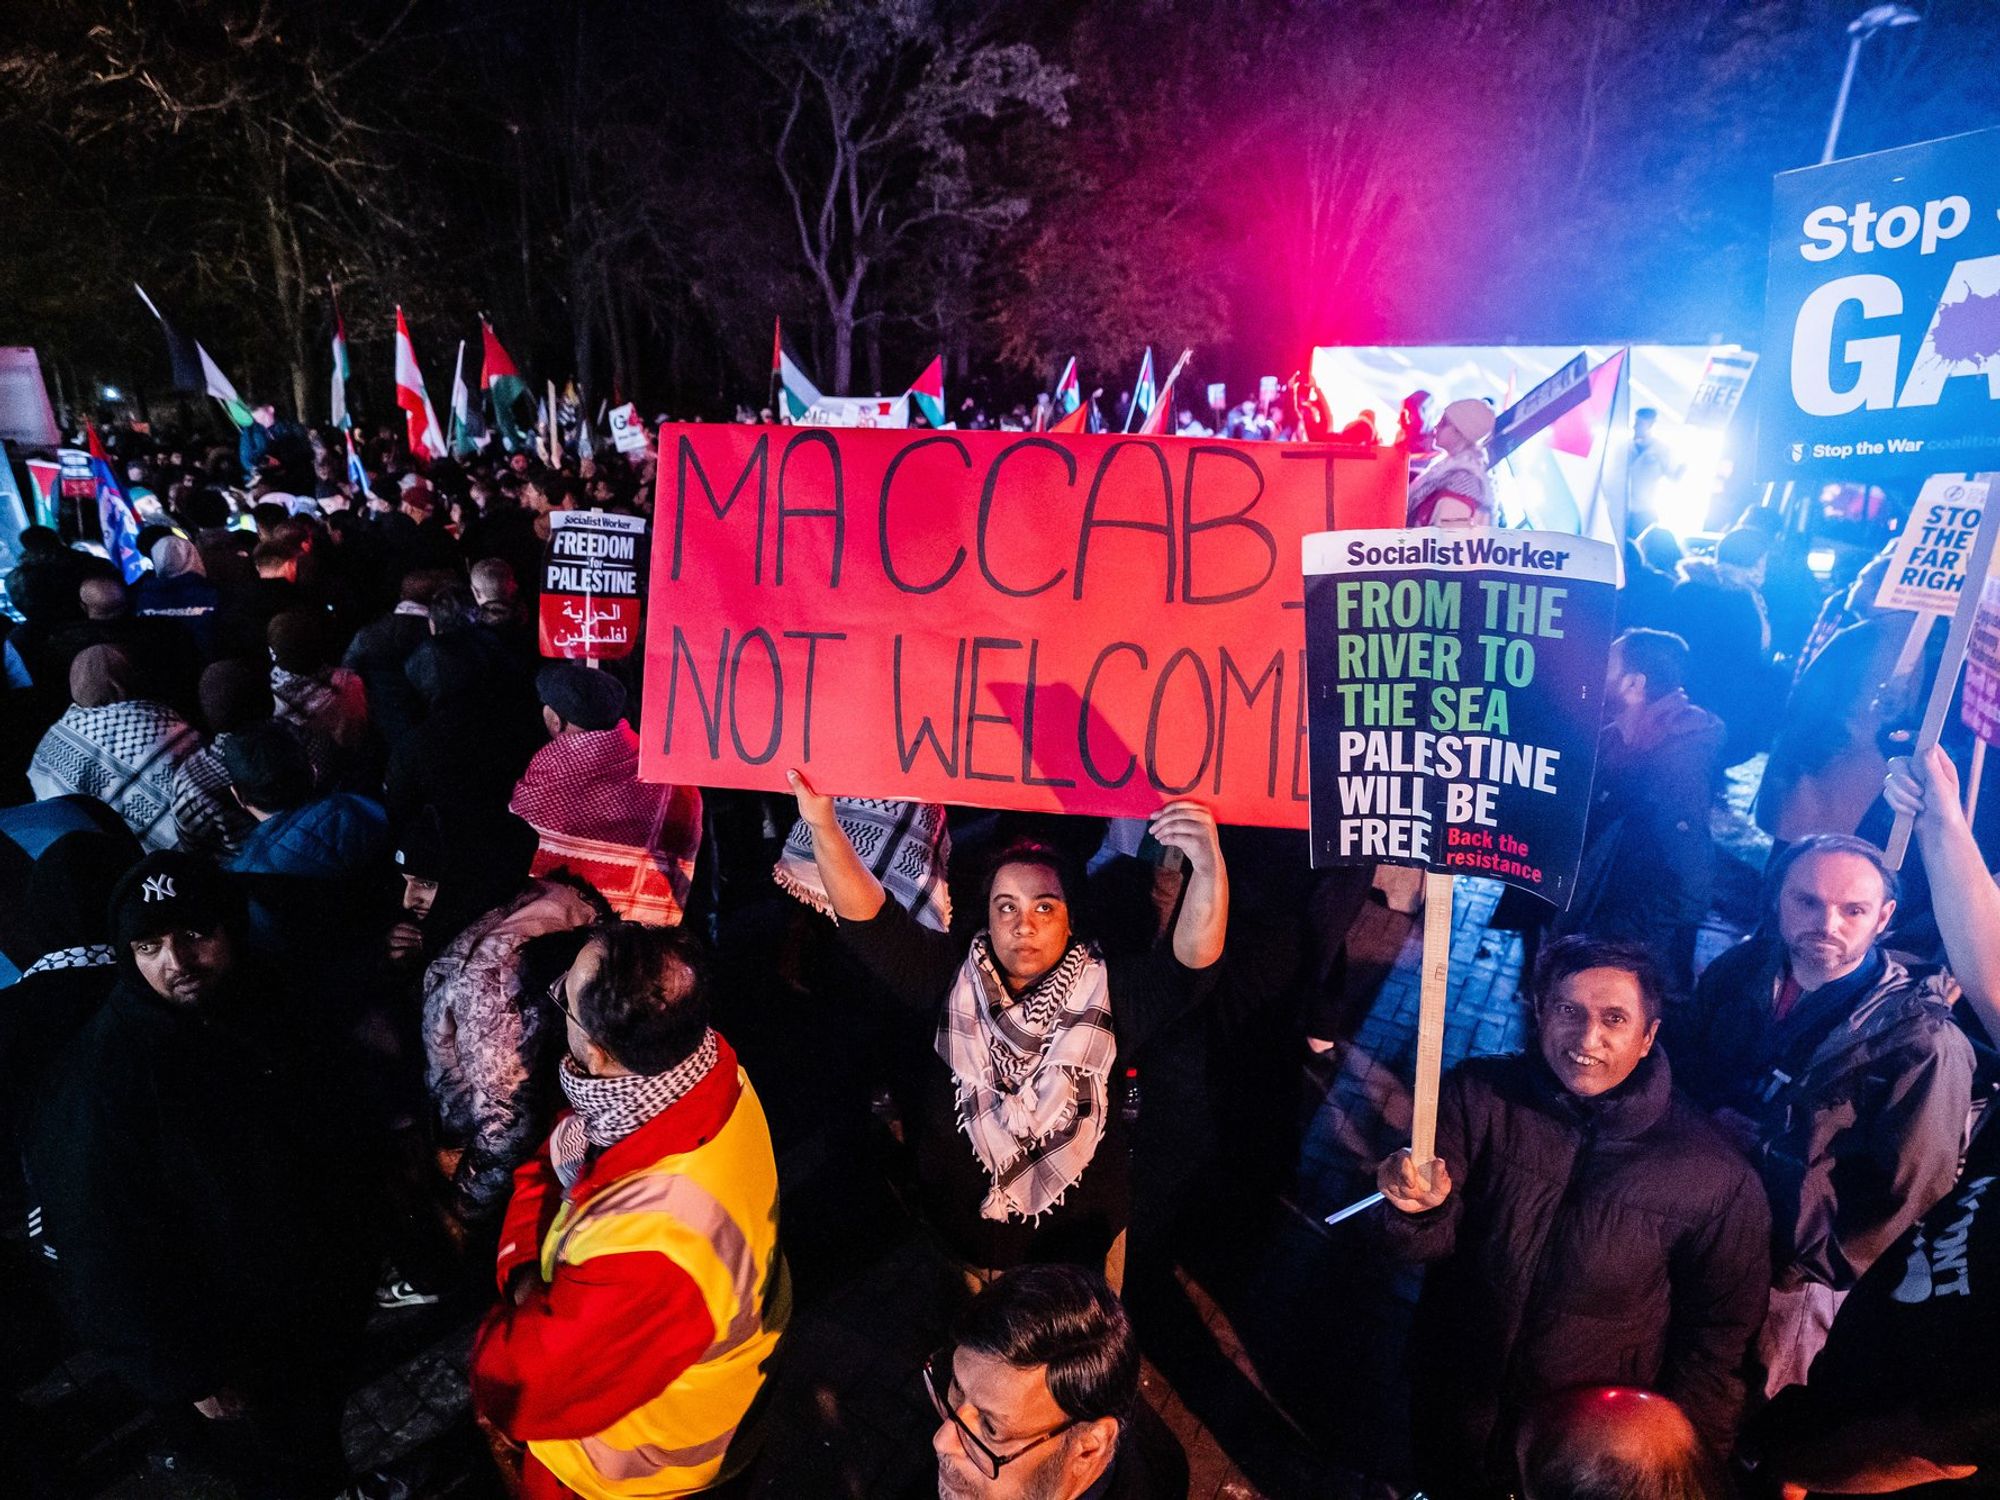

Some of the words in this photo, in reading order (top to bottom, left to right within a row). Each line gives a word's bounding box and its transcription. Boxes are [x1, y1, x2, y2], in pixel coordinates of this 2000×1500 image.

[1800, 195, 1971, 262] Stop
[1791, 254, 2000, 417] GA
[1812, 443, 1853, 459] Stop
[1856, 441, 1885, 455] the
[1887, 438, 1924, 454] War
[564, 515, 601, 527] Socialist
[601, 517, 632, 529] Worker
[671, 428, 1377, 609] MACCABI
[1926, 504, 1982, 529] STO
[553, 531, 635, 560] FREEDOM
[1920, 526, 1974, 550] THE
[589, 556, 604, 569] for
[1347, 538, 1464, 567] Socialist
[1466, 538, 1570, 571] Worker
[1908, 546, 1961, 571] FAR
[547, 566, 637, 594] PALESTINE
[1899, 567, 1965, 593] RIGH
[562, 600, 621, 625] الحرية
[1337, 579, 1462, 630] FROM
[1479, 580, 1568, 639] THE
[1338, 632, 1462, 682] RIVER
[1478, 635, 1536, 688] TO
[664, 625, 847, 765] NOT
[1337, 683, 1416, 727] THE
[1430, 686, 1509, 736] SEA
[1339, 731, 1561, 794] PALESTINE
[1338, 775, 1432, 820] WILL
[1446, 783, 1500, 827] BE
[1340, 818, 1432, 863] FREE
[1446, 827, 1493, 849] Back
[1499, 832, 1529, 858] the
[1446, 851, 1543, 883] resistance
[141, 873, 177, 903] NY
